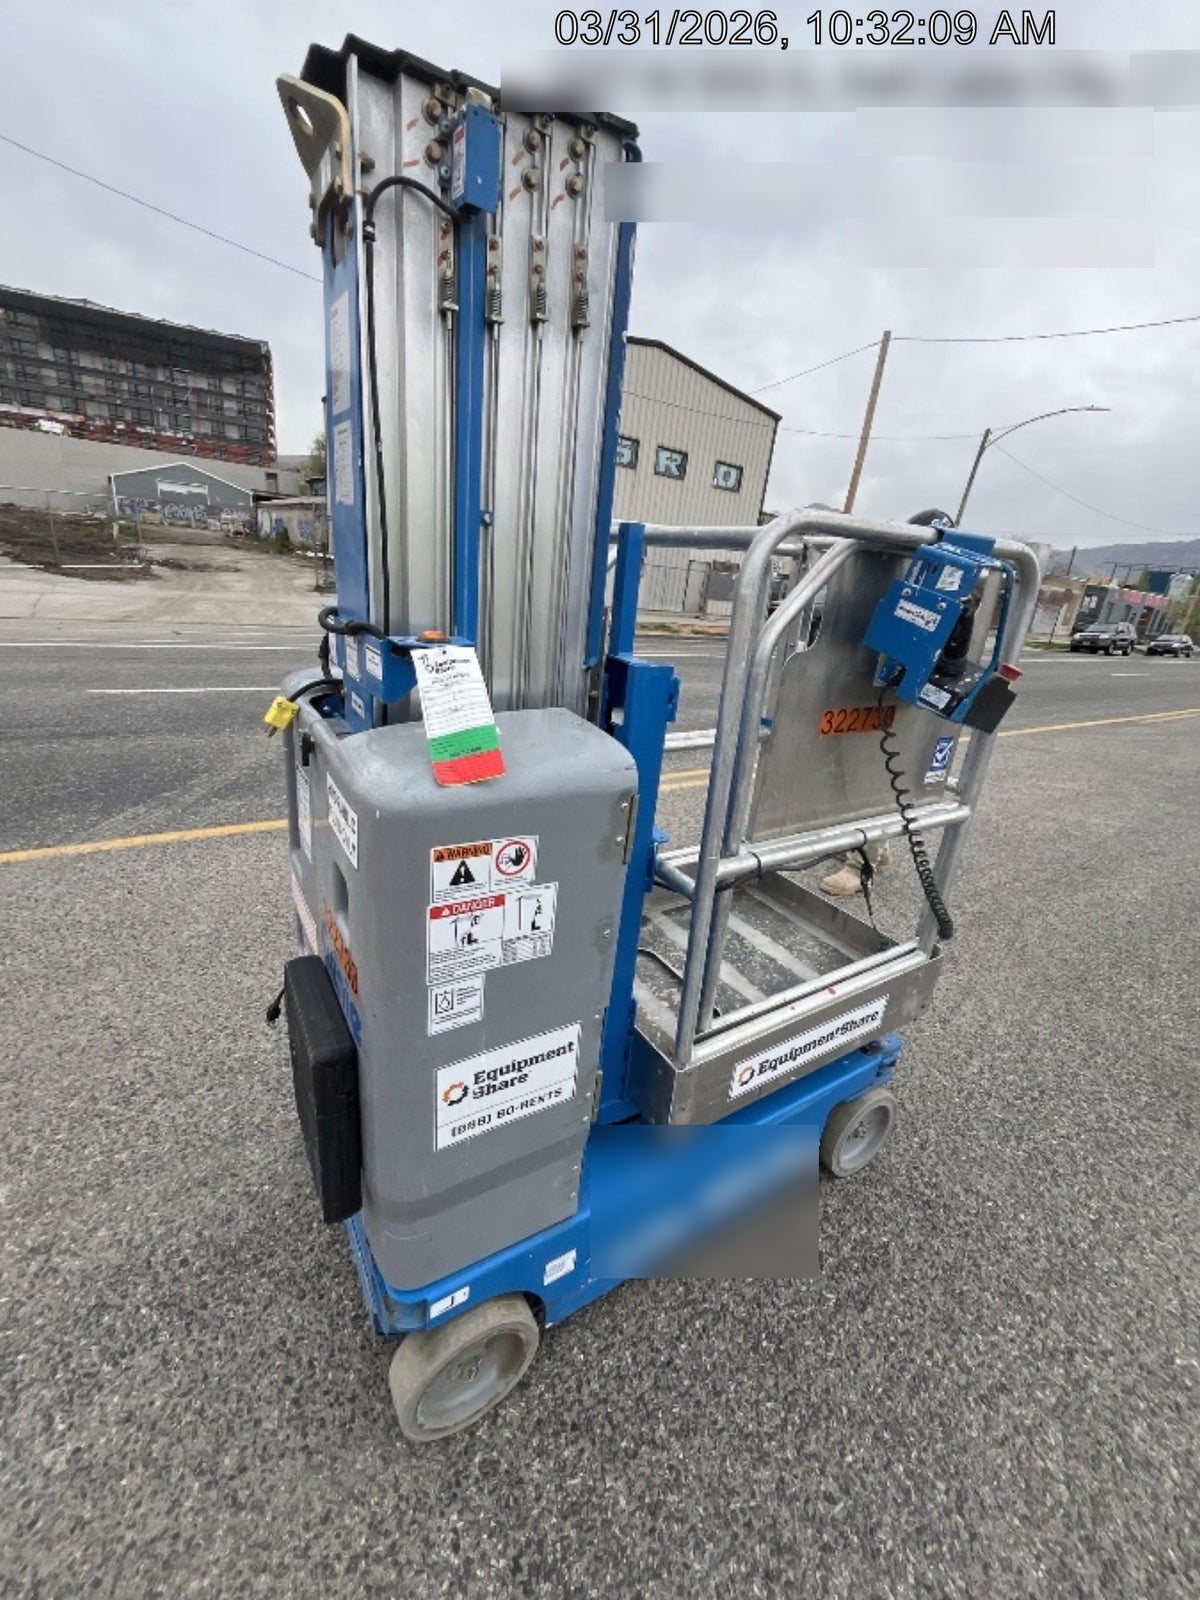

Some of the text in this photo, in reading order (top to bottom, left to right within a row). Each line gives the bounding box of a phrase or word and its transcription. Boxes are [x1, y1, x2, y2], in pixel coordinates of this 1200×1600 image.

[452, 896, 497, 915] DANGER
[473, 1041, 575, 1085] Equipment
[472, 1072, 529, 1100] Share
